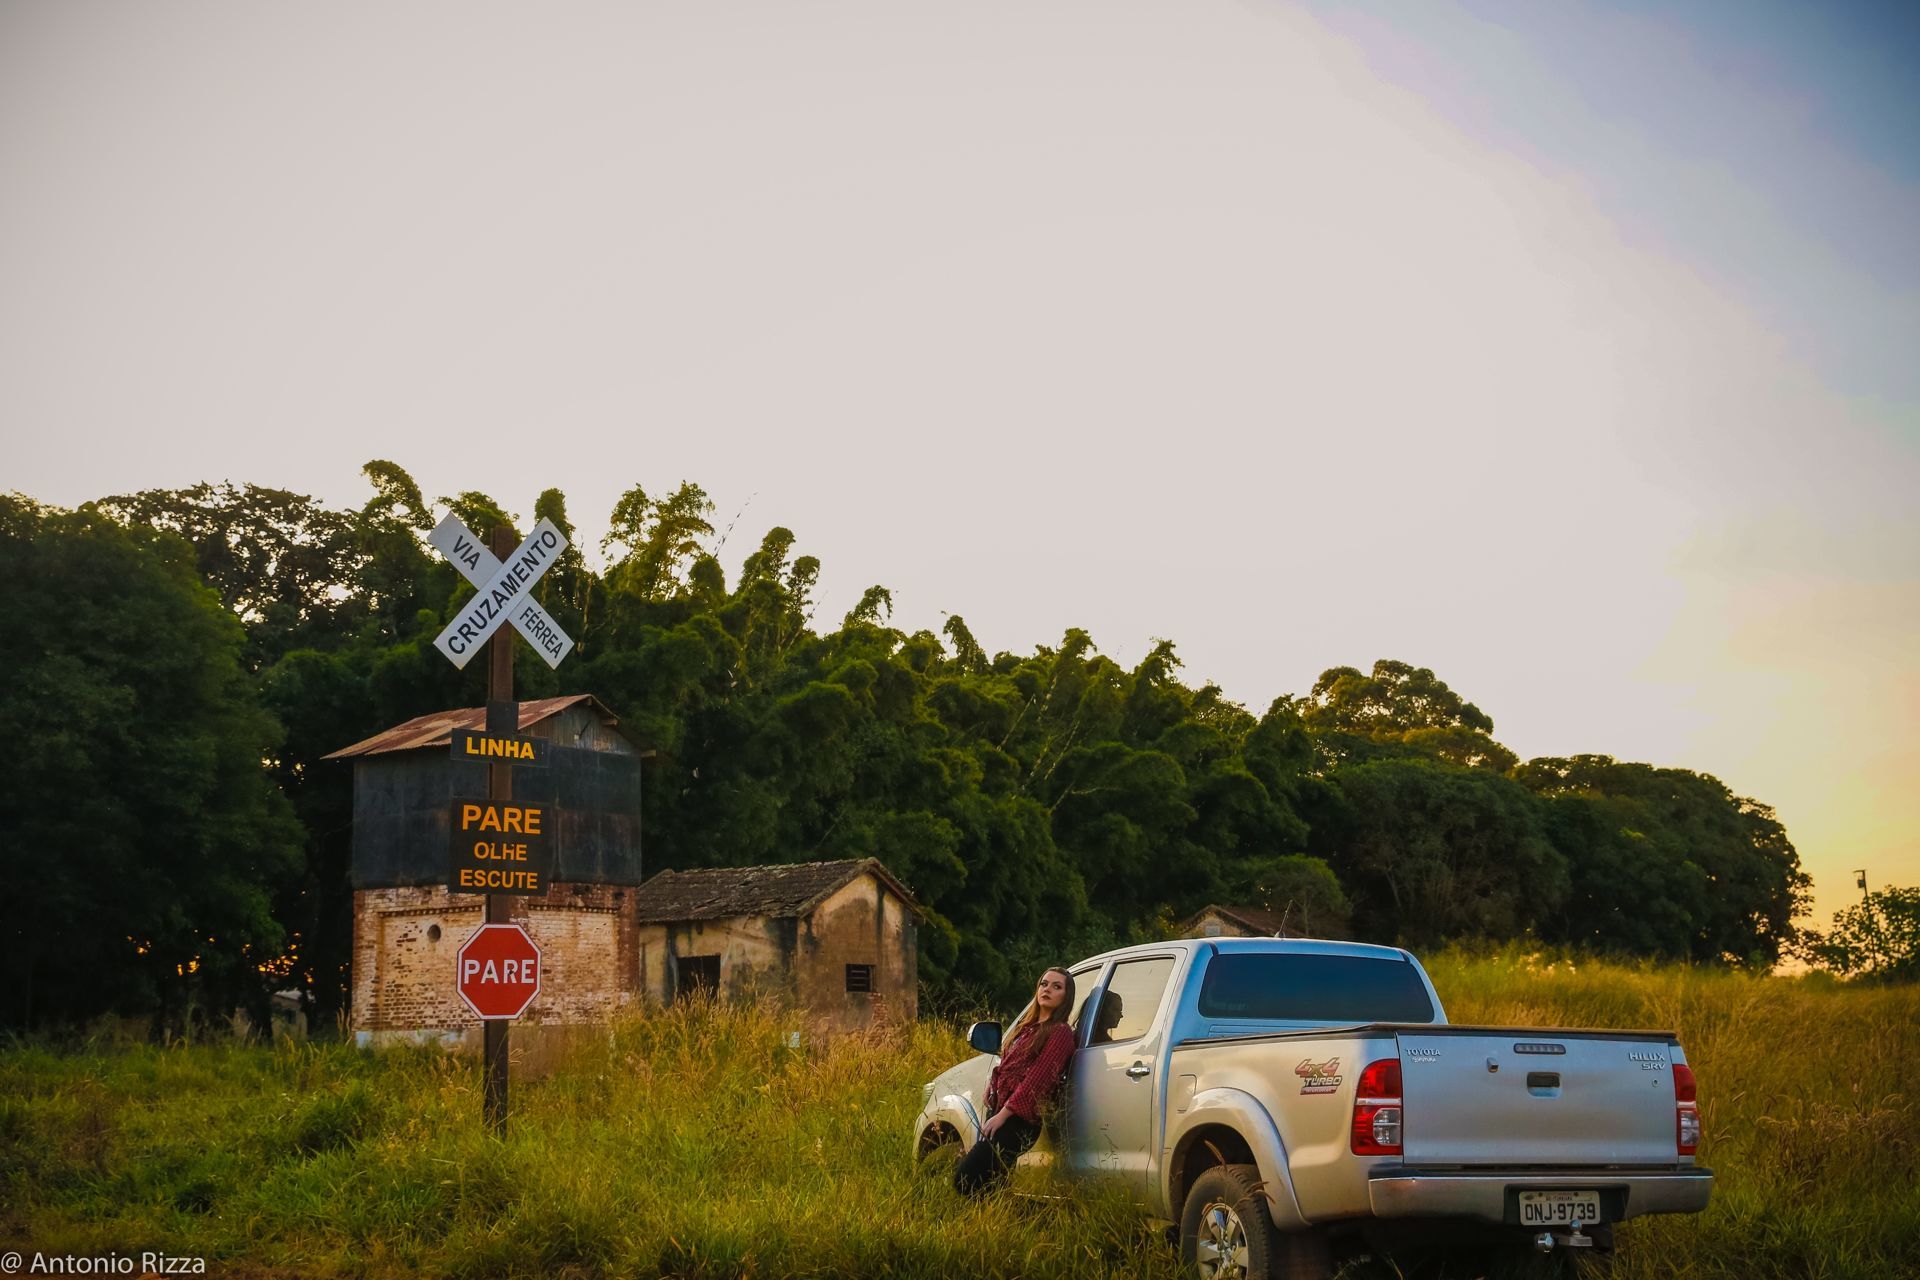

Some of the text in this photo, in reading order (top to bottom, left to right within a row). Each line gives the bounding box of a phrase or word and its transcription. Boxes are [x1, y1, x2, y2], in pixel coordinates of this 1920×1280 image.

[453, 535, 481, 570] VIA
[448, 531, 557, 654] CRUZAMENTO
[519, 606, 564, 658] FÉRREA
[466, 737, 535, 759] LINHA
[462, 805, 541, 835] PARE
[473, 842, 528, 861] OLHE
[460, 869, 538, 889] ESCUTE
[463, 959, 535, 984] PARE
[1407, 1048, 1441, 1056] TOYOTA
[1629, 1052, 1665, 1061] HILUX
[1305, 1077, 1342, 1086] TURBO
